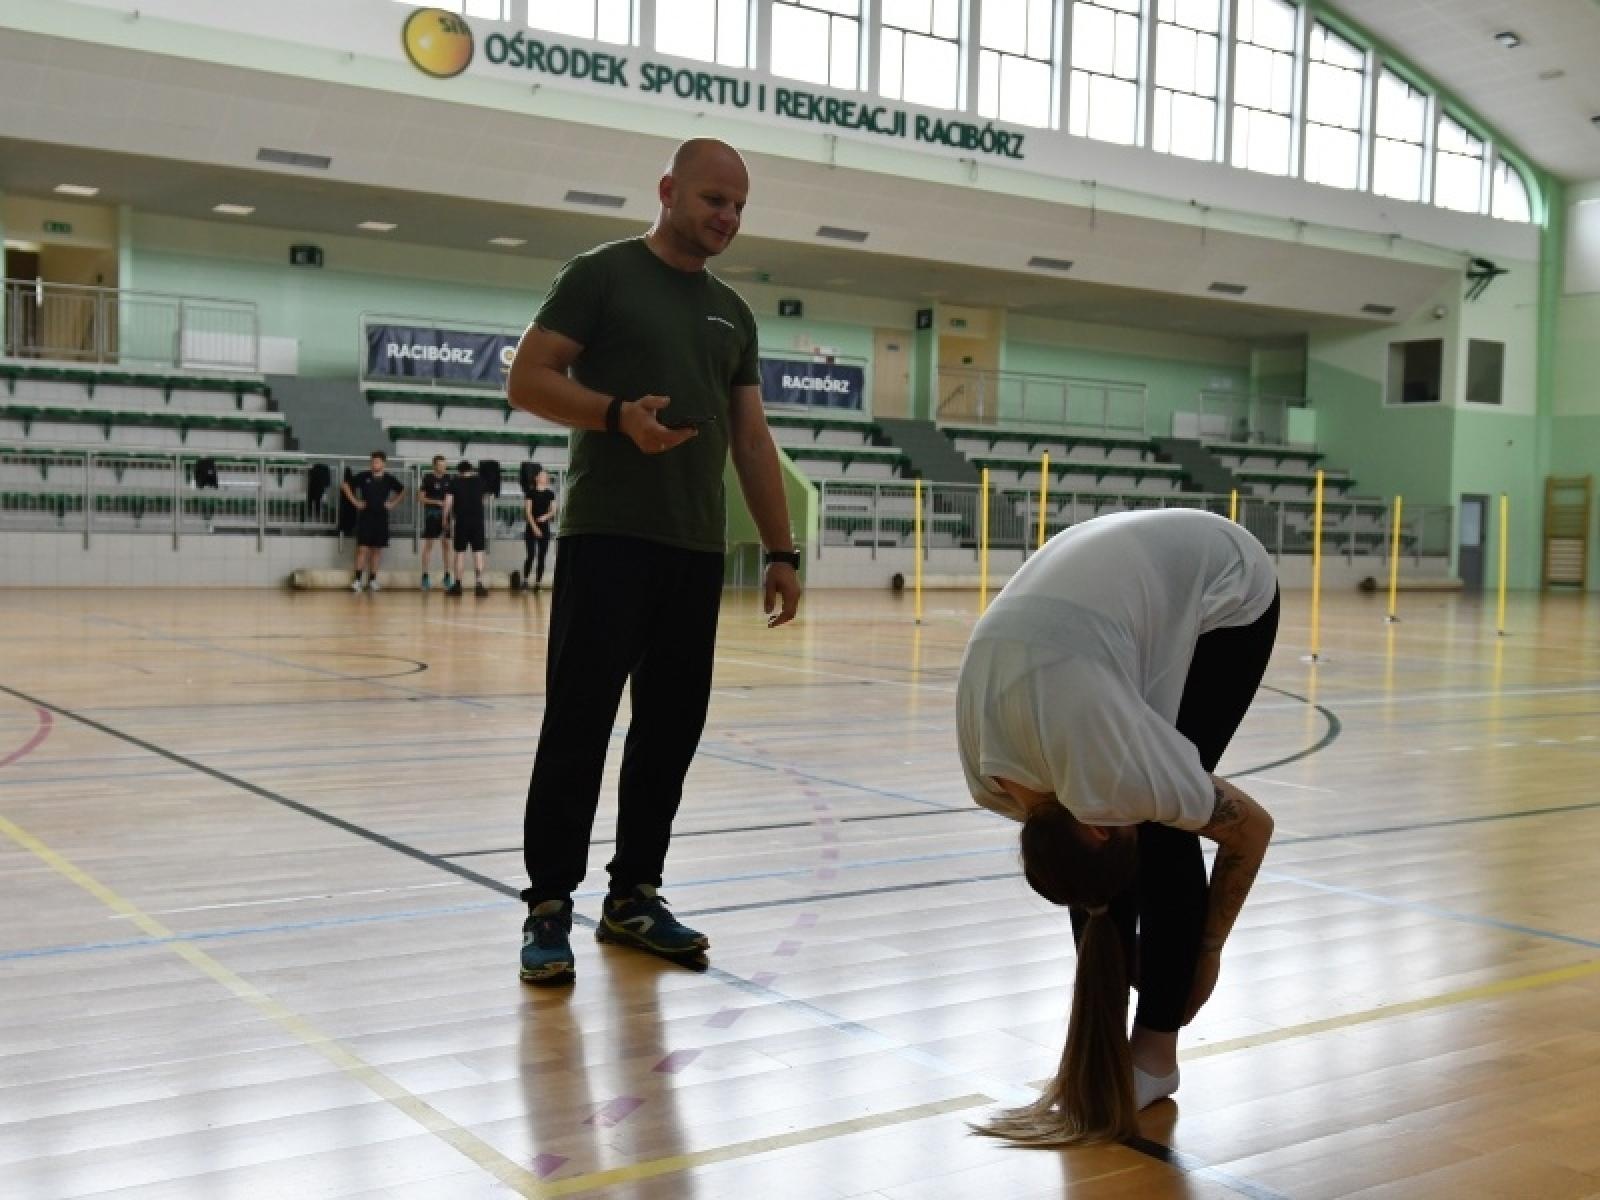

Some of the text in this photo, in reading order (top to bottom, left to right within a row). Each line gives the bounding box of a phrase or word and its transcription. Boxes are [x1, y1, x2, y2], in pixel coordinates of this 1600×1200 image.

[485, 30, 1025, 159] OŚRODEK SPORTU I REKREACJI RACIBÓRZ
[387, 341, 475, 365] RACIBÓRZ
[782, 373, 850, 394] RACIBÓRZ
